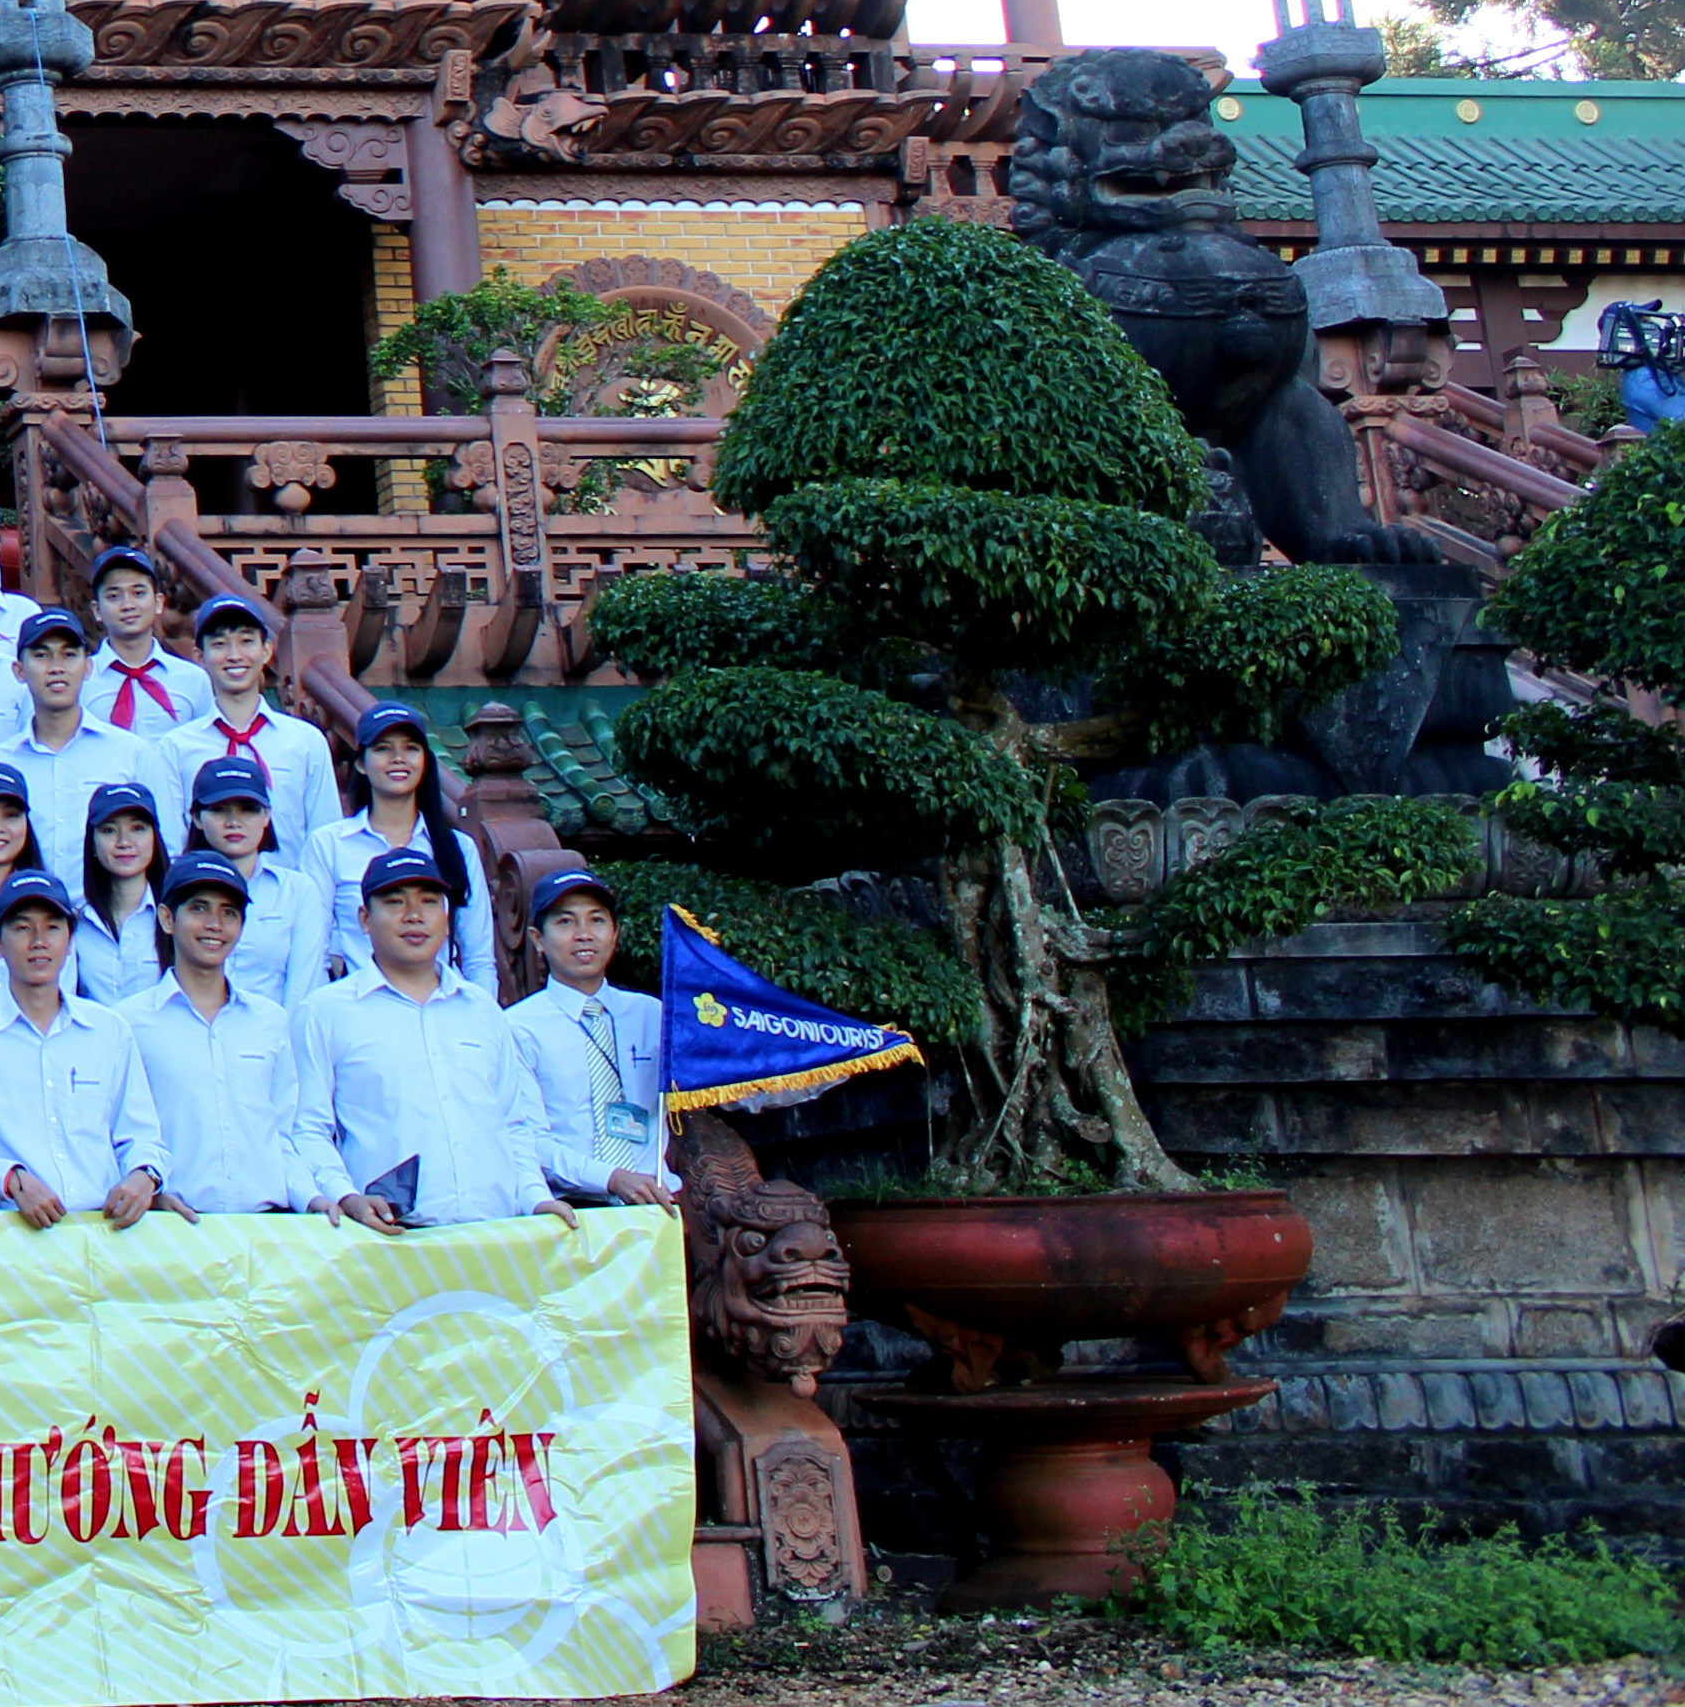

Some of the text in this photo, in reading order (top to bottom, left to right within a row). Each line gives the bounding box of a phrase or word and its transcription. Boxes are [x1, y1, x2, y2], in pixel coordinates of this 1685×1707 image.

[731, 1005, 886, 1050] SAIGONTOURIST
[232, 1388, 378, 1539] DẪN
[394, 1408, 558, 1539] VIÊN
